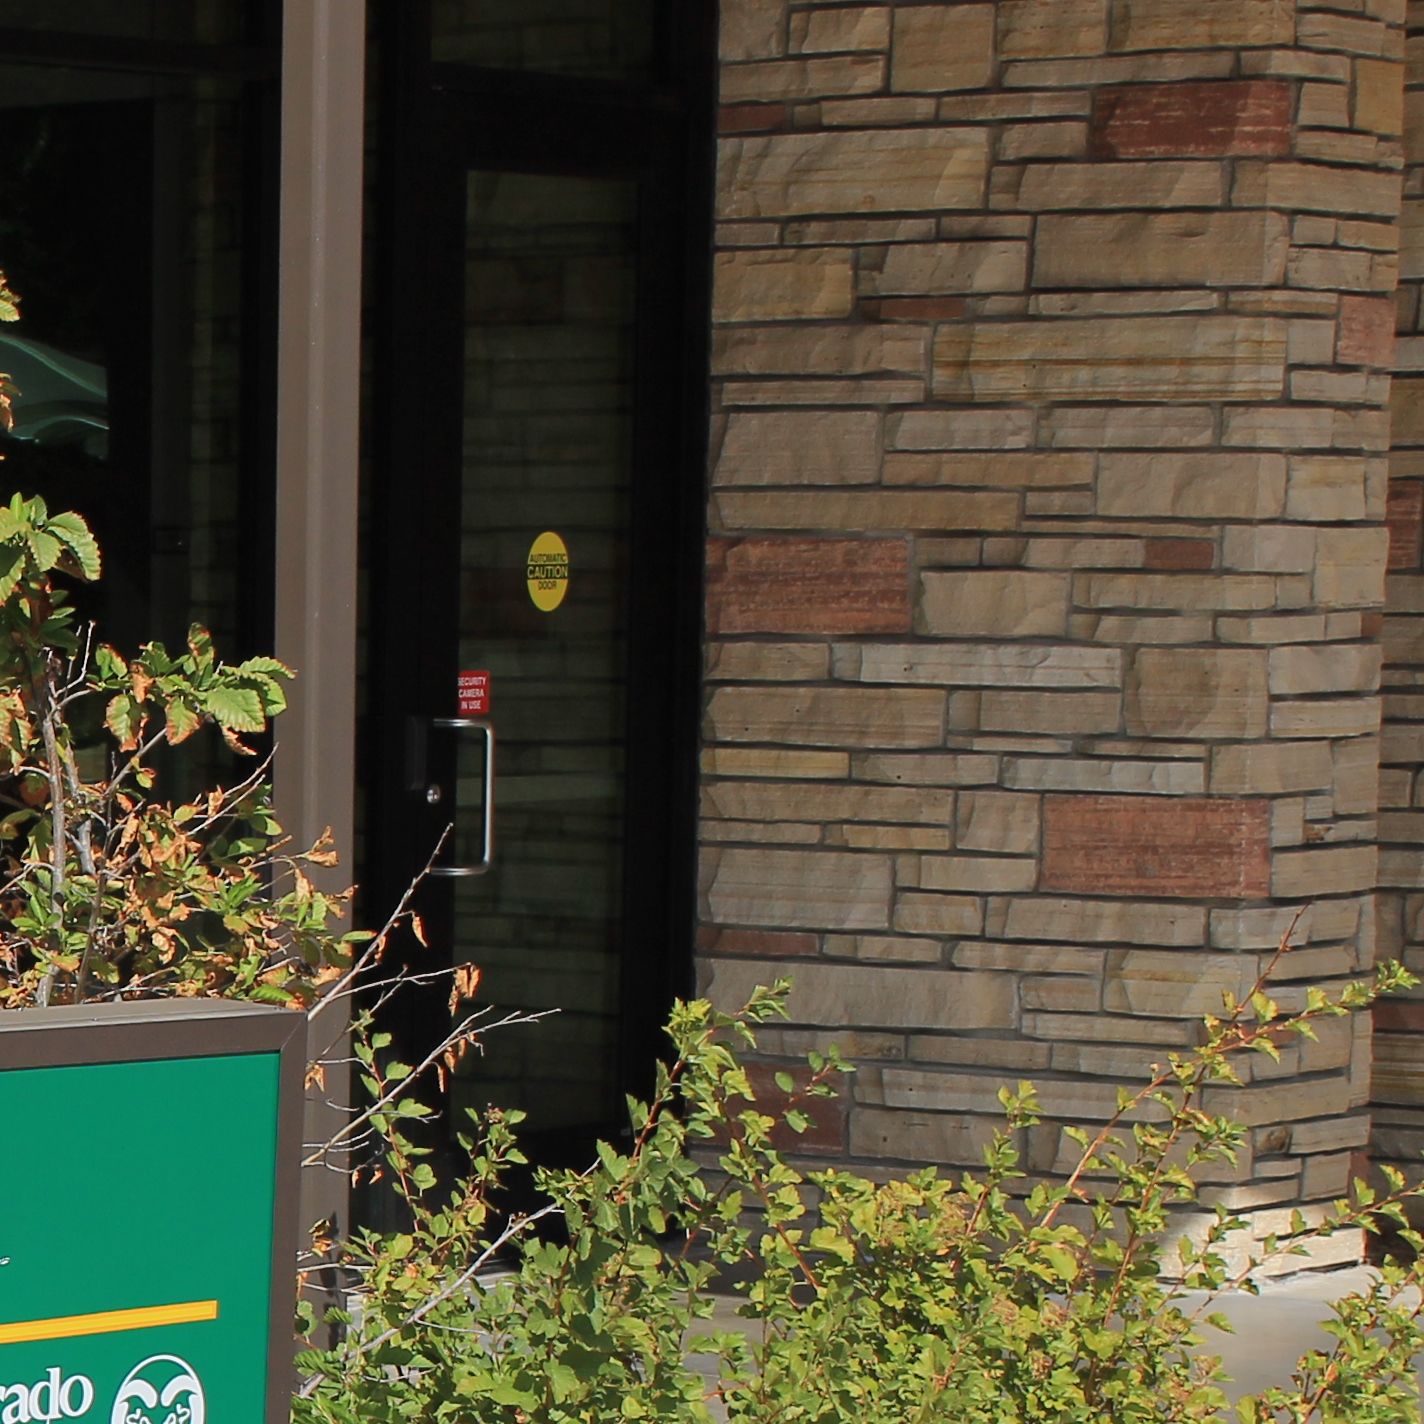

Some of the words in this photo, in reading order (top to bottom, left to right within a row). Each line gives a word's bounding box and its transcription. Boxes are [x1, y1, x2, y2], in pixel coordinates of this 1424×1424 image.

[527, 566, 567, 578] CAUTION
[538, 581, 557, 590] DOOR
[458, 676, 486, 686] SECURITY
[458, 688, 485, 698] CAMERA
[468, 699, 482, 710] USE
